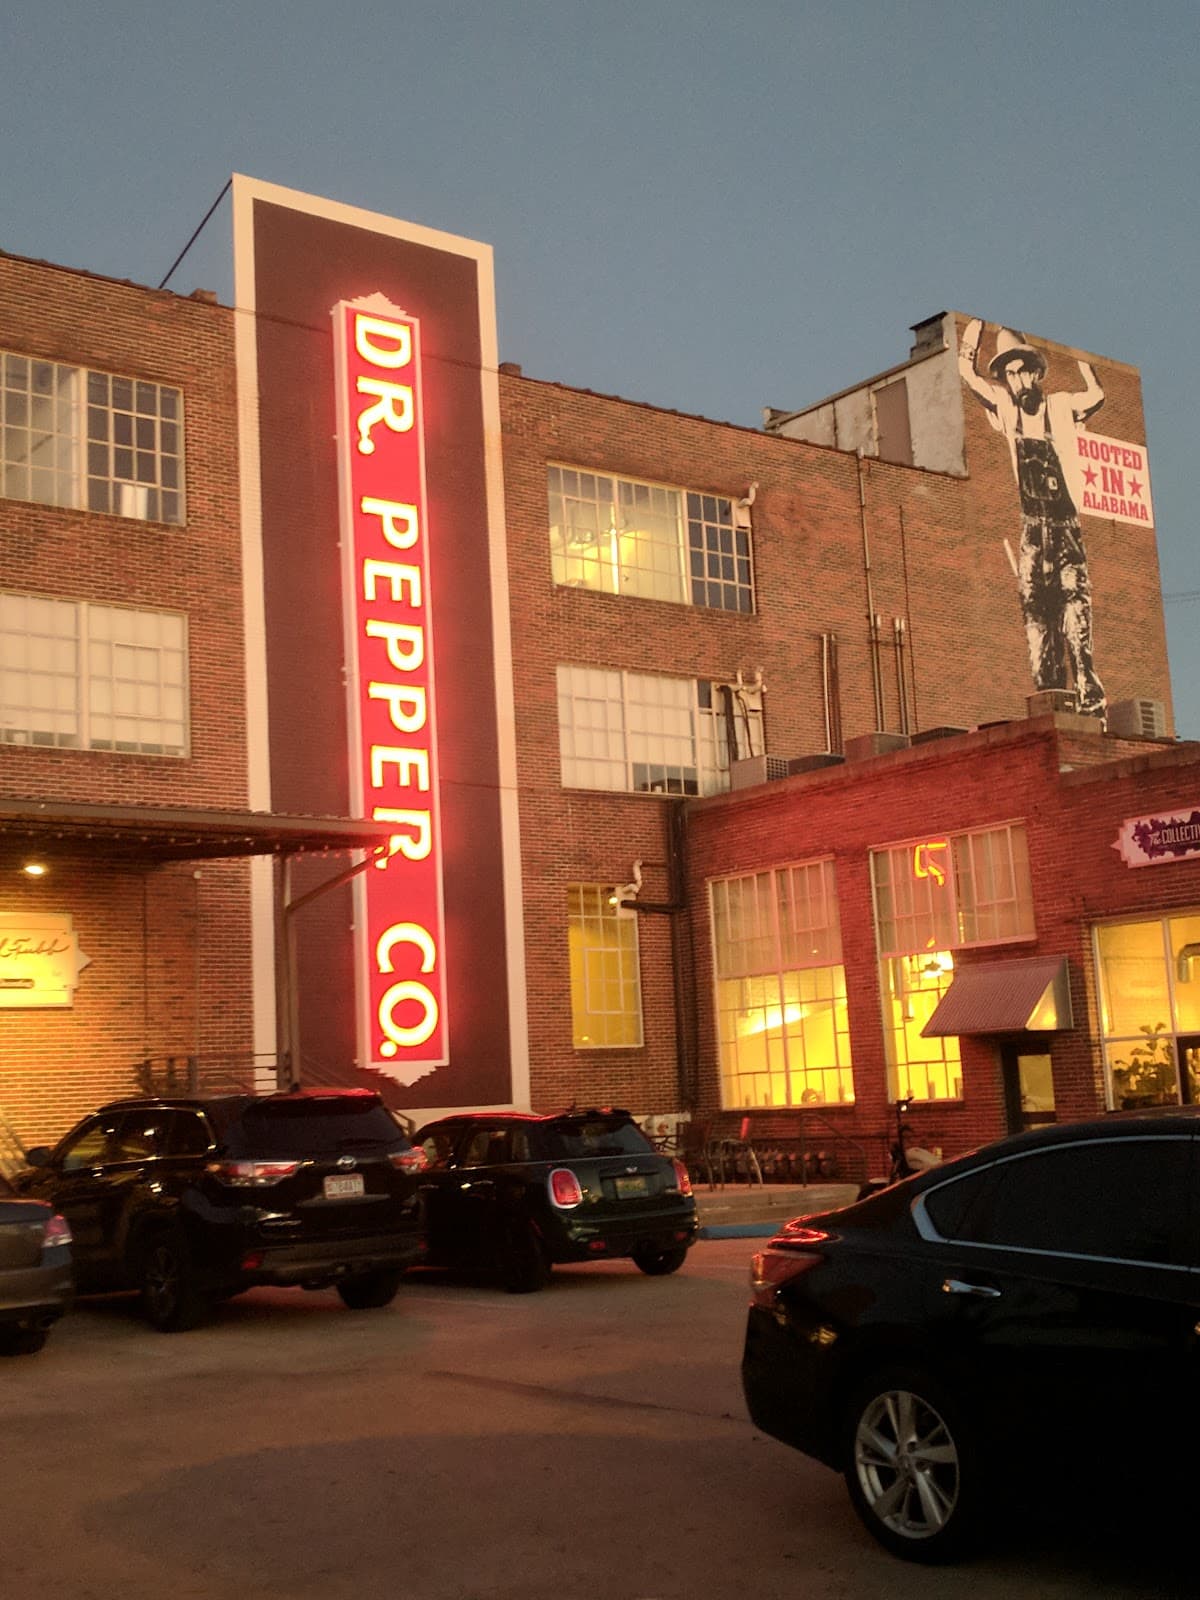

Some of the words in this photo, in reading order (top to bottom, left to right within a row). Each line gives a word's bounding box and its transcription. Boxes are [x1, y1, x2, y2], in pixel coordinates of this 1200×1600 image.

[356, 313, 414, 455] DR.
[1077, 437, 1142, 471] ROOTED
[1101, 465, 1124, 496] IN
[1083, 490, 1149, 521] ALABAMA
[361, 496, 432, 869] PEPPER
[376, 922, 439, 1058] CO.
